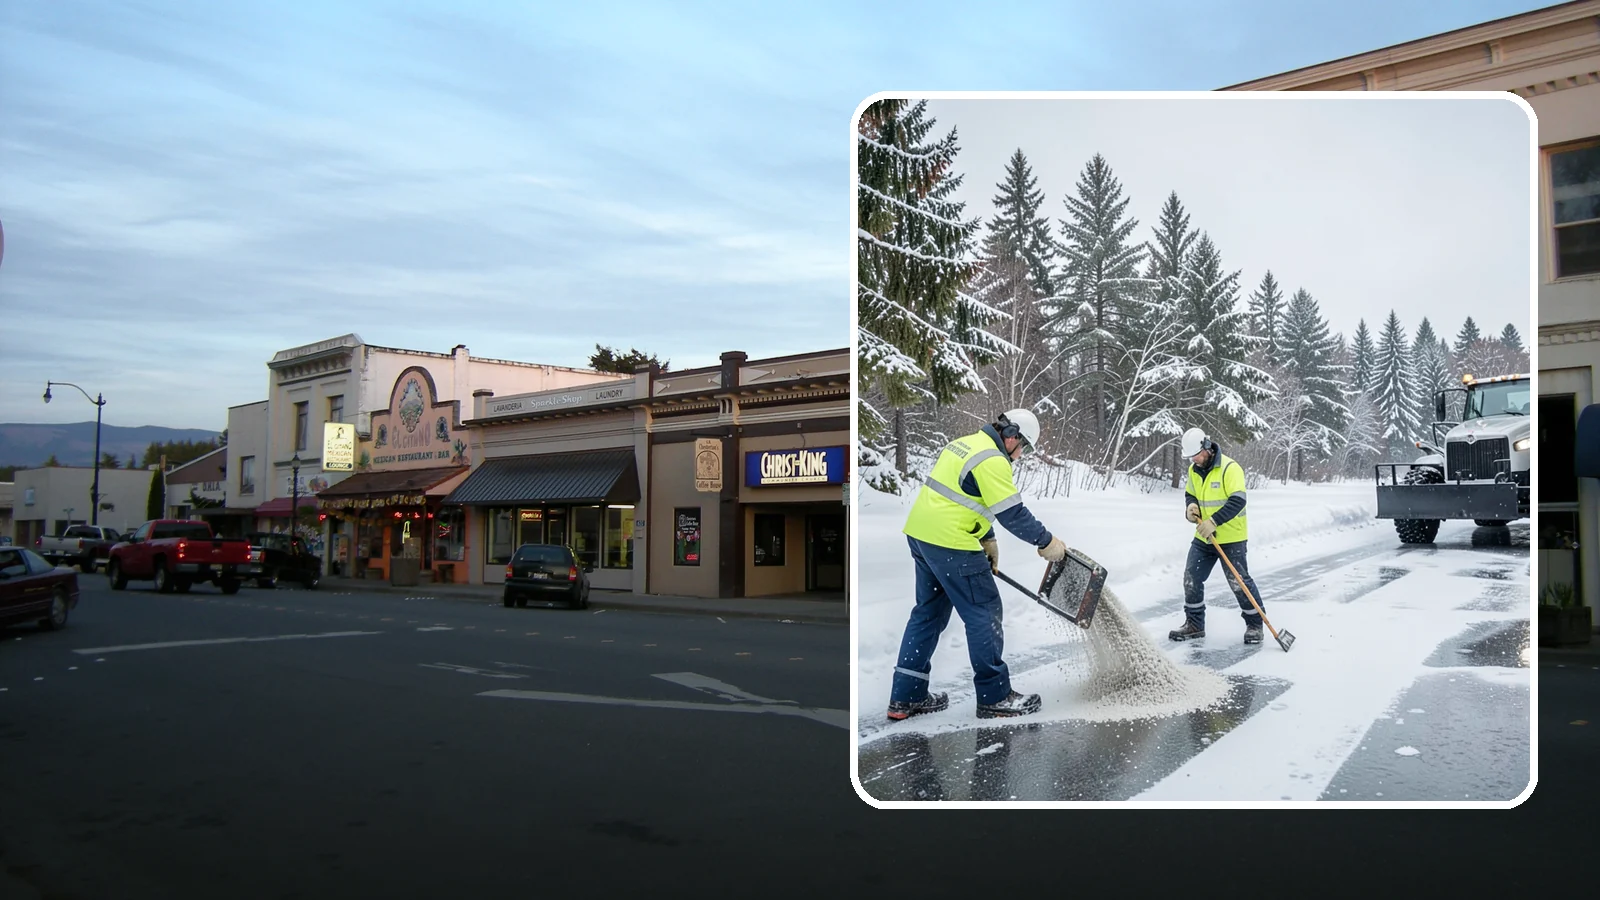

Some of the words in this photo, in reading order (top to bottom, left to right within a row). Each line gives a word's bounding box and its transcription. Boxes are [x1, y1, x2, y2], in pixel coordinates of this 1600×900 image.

[562, 394, 582, 405] Shop
[595, 388, 624, 400] LAUNDRY
[493, 402, 523, 412] LAVANDERIA
[373, 454, 396, 464] MEXICAN
[397, 451, 433, 462] RESTAURANT
[438, 450, 450, 458] BAR
[761, 452, 797, 478] CHRIST
[799, 450, 828, 476] KING
